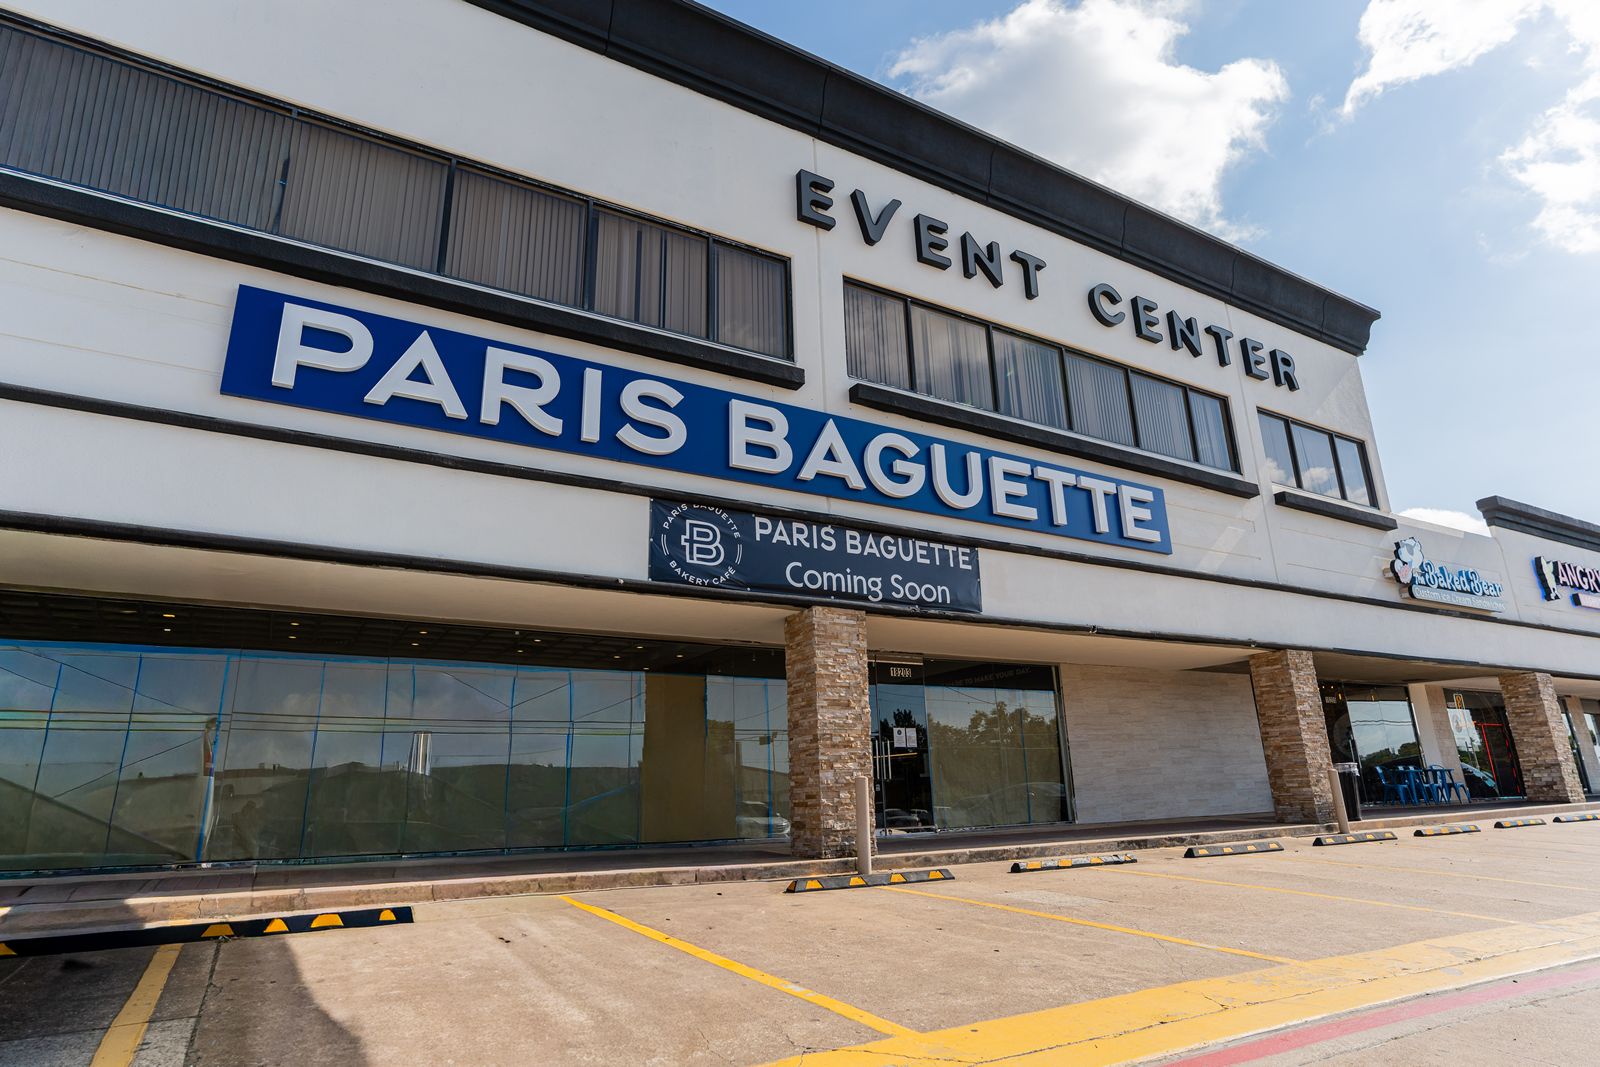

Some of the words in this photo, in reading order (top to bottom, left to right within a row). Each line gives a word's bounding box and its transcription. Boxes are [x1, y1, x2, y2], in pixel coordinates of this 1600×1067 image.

[796, 168, 1046, 300] EVENT
[1087, 283, 1300, 391] CENTER
[271, 302, 687, 456] PARIS
[728, 398, 1162, 542] BAGUETTE
[662, 503, 688, 530] PARIS
[754, 516, 836, 551] PARIS
[845, 530, 973, 570] BAGUETTE
[669, 560, 709, 586] BAKERY
[785, 561, 882, 601] Coming
[890, 574, 951, 604] Soon
[1423, 560, 1471, 591] Baked
[1469, 568, 1503, 597] Bear
[889, 666, 912, 678] 18203
